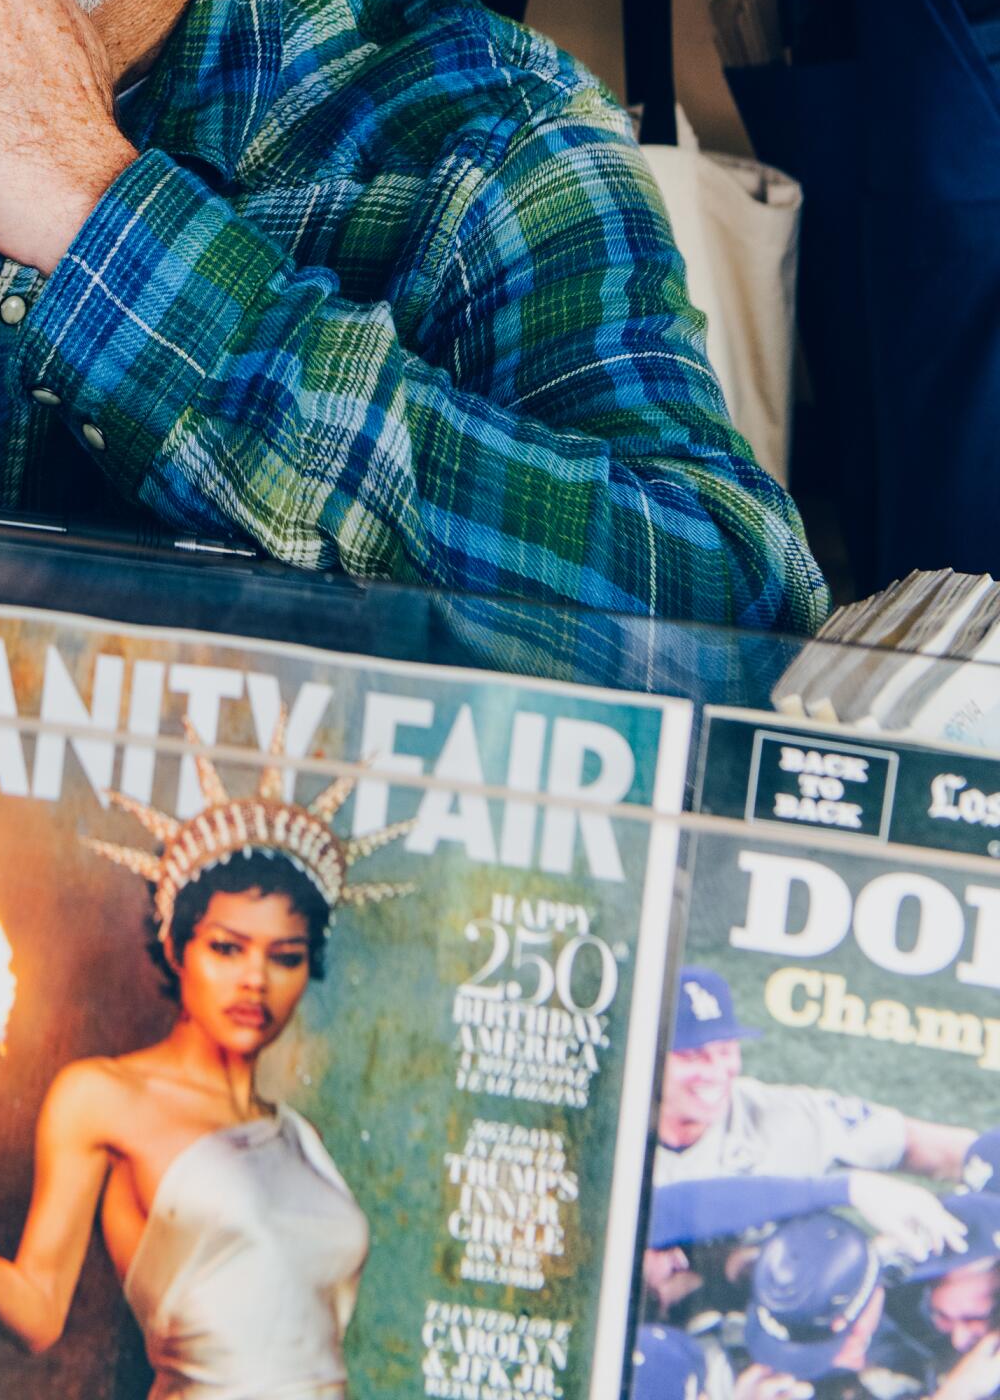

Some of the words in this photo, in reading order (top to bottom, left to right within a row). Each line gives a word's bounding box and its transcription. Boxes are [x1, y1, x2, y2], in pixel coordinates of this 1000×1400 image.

[779, 745, 869, 784] BACK
[351, 690, 638, 882] FAIR
[796, 774, 845, 801] TO
[927, 772, 1000, 828] Los
[773, 792, 863, 830] BACK
